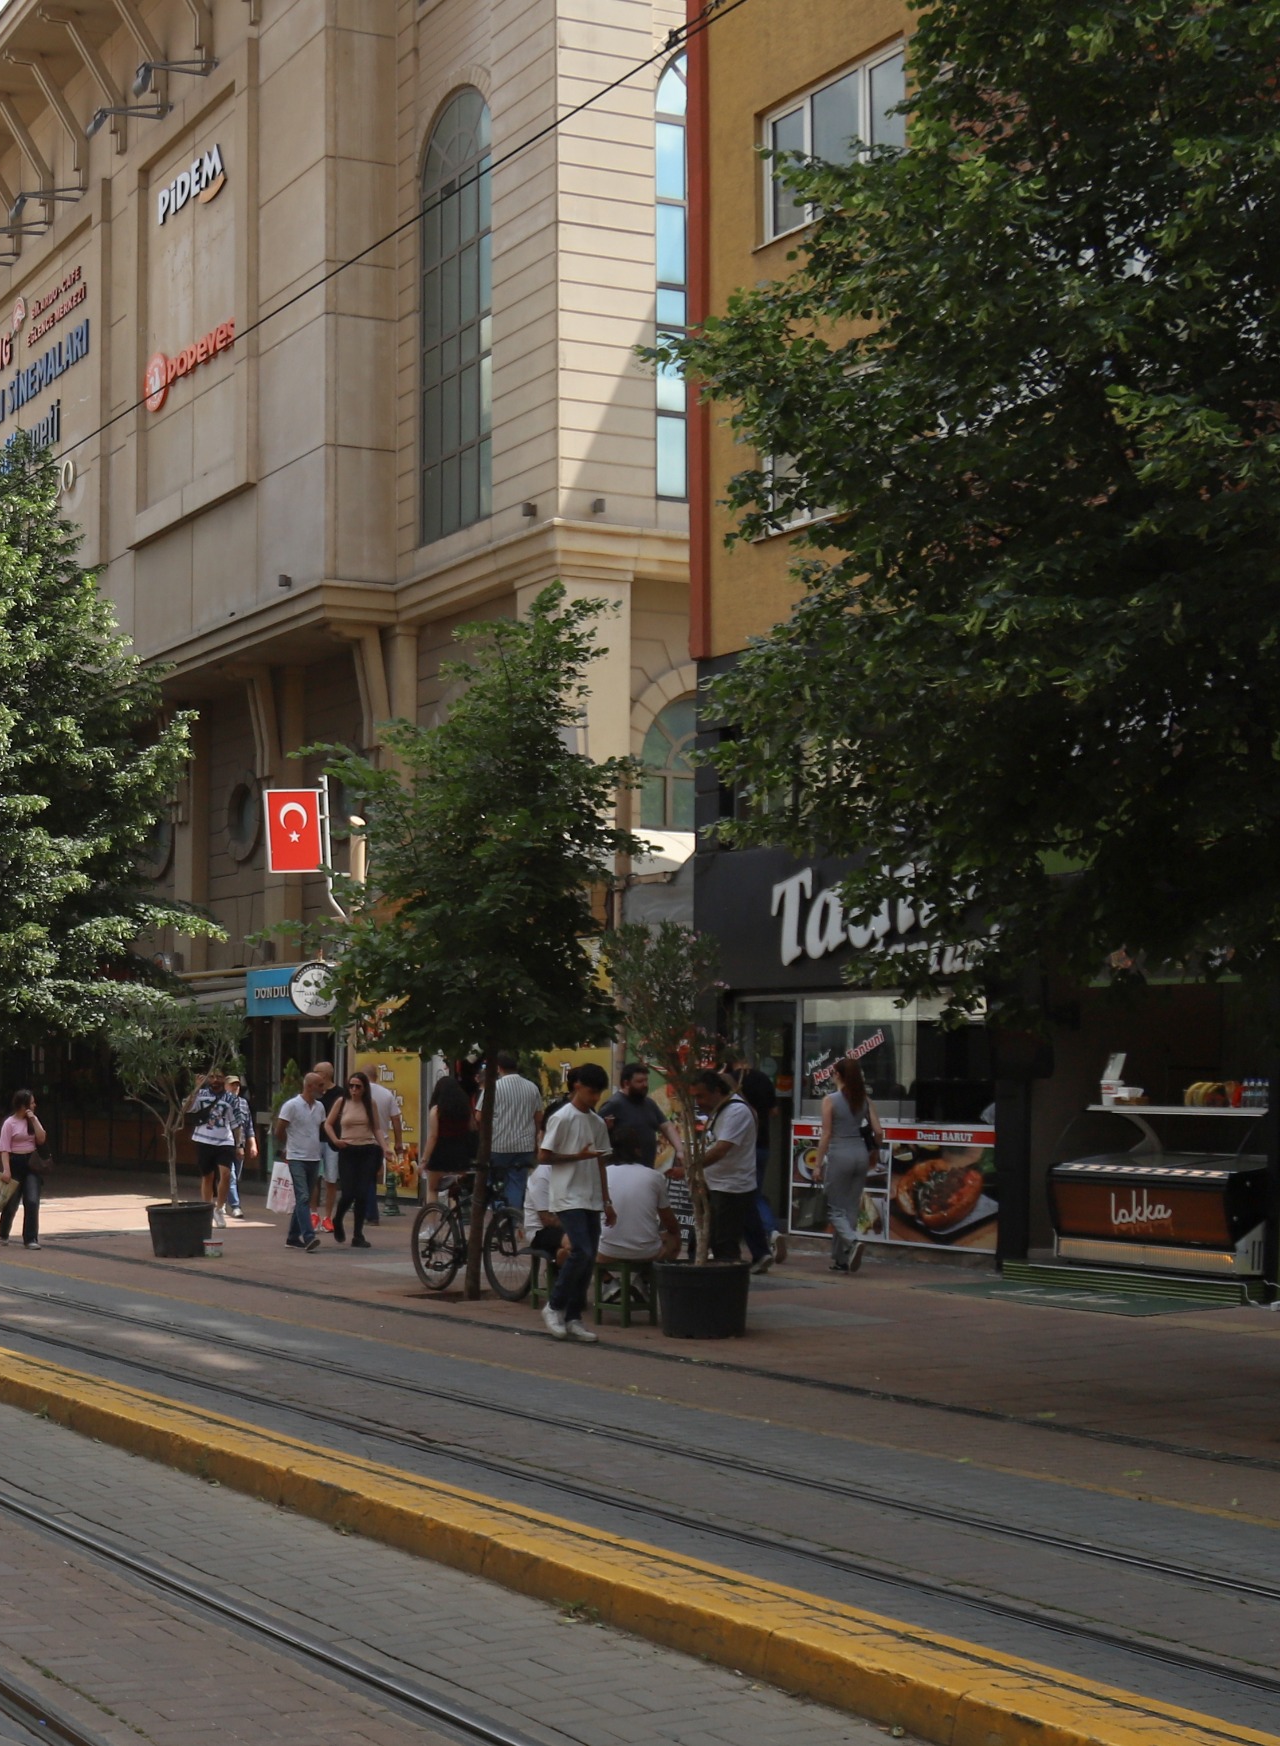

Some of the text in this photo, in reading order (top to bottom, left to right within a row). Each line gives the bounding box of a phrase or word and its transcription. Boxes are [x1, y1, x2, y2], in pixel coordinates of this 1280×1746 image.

[54, 281, 87, 323] MERKEZİ
[9, 318, 90, 415] SİNEMALARI
[916, 1131, 941, 1141] Deniz
[942, 1132, 974, 1143] BARUT
